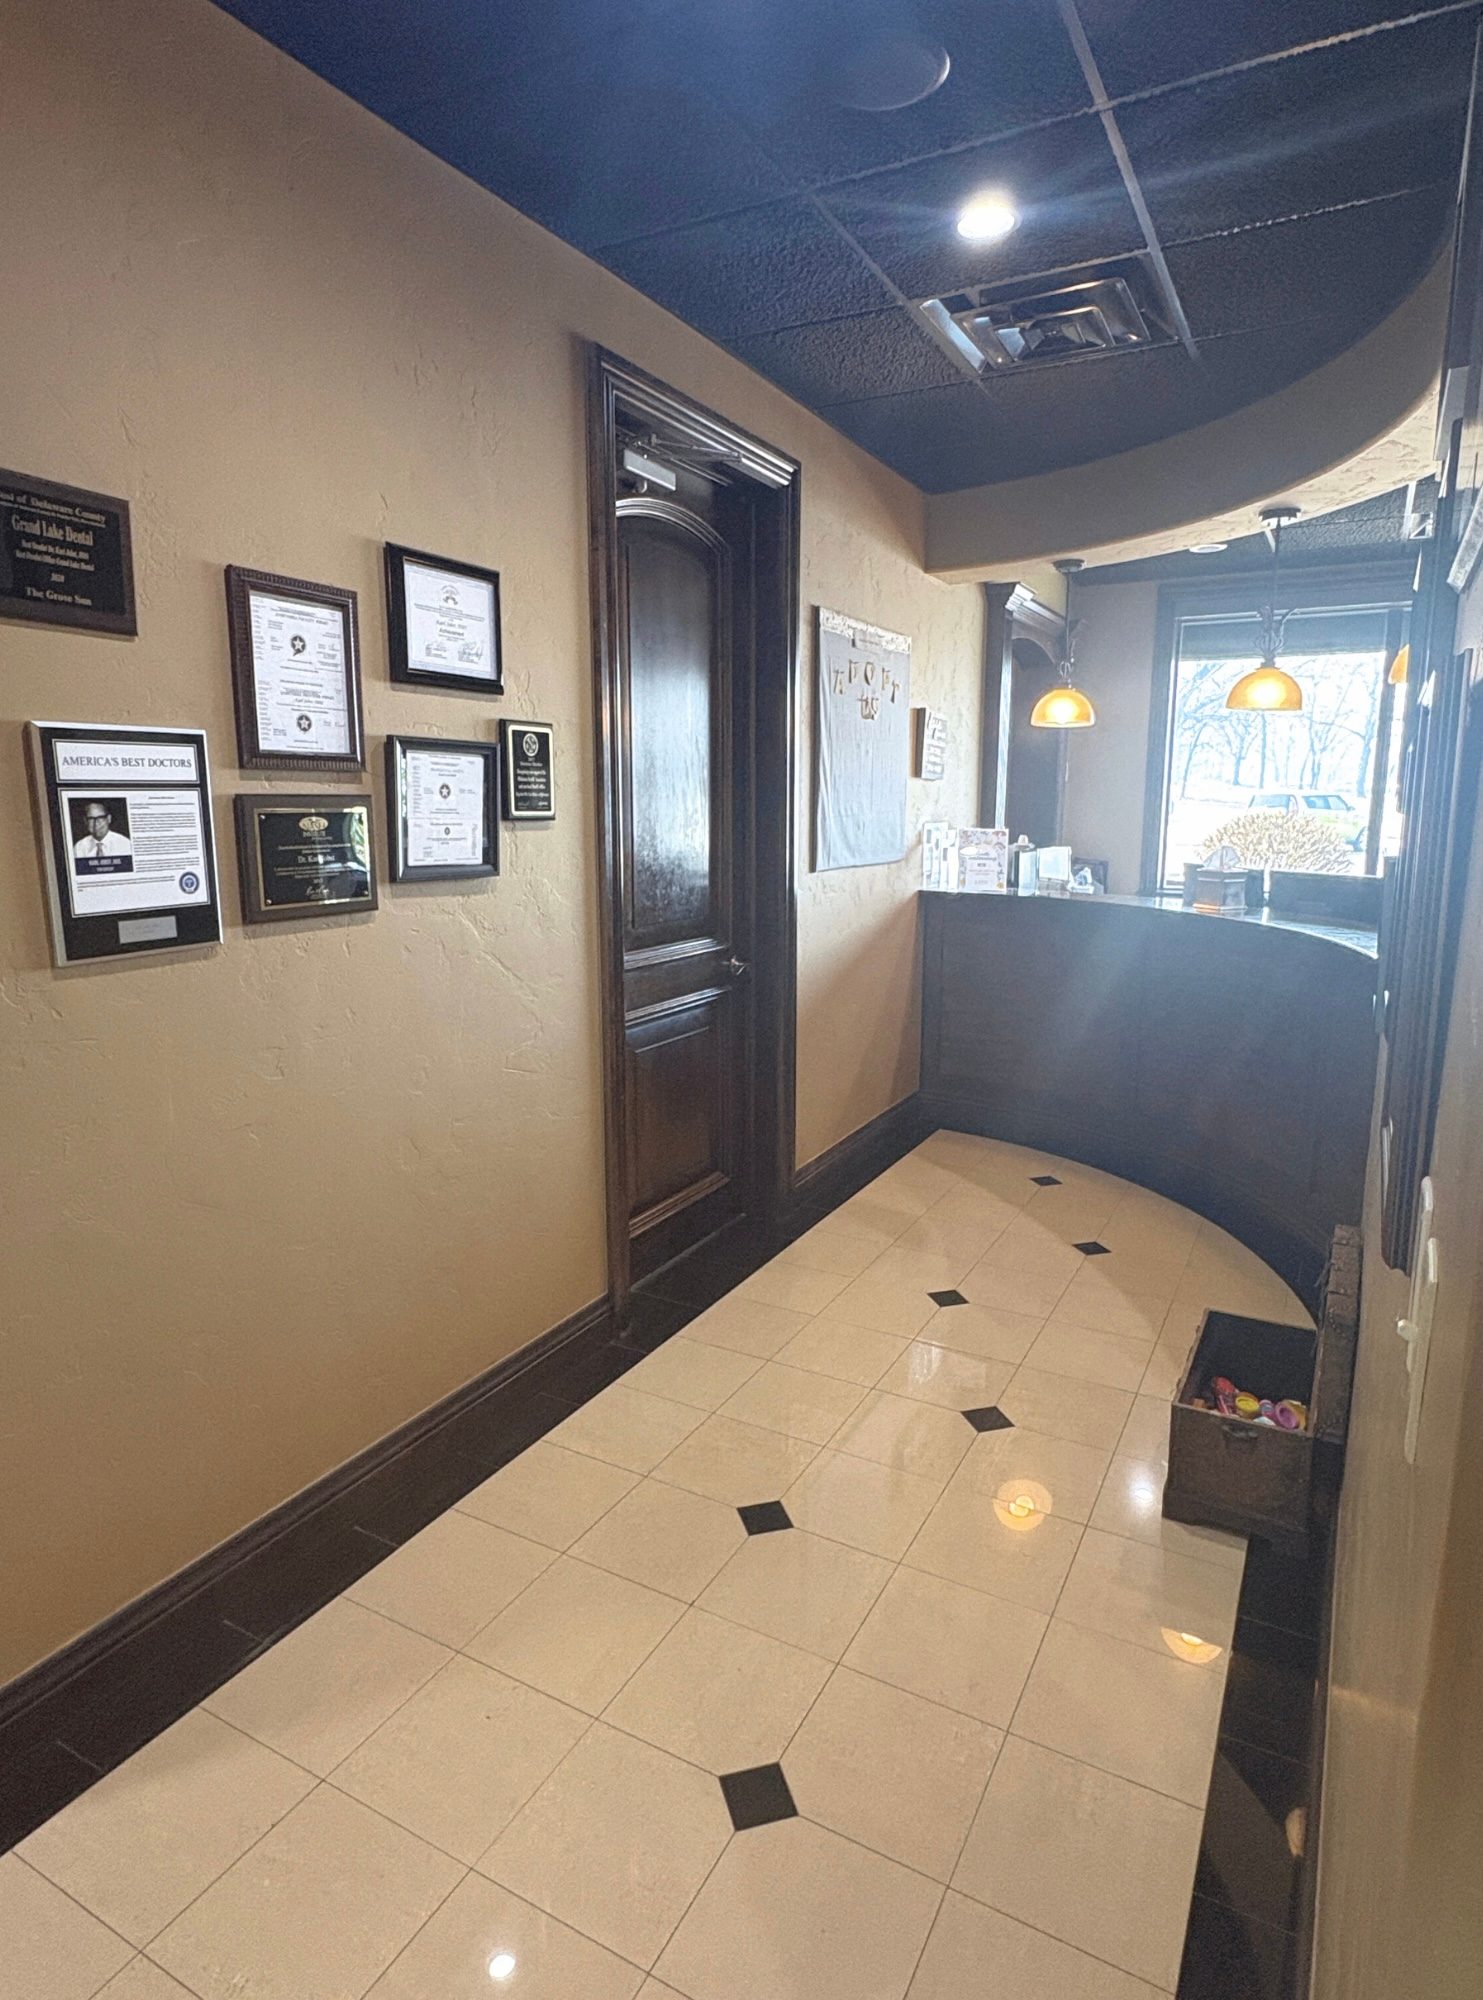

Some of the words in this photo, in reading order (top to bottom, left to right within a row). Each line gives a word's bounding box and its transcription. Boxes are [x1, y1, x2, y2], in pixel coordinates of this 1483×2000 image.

[31, 497, 74, 515] Delaware
[75, 508, 106, 524] County
[12, 514, 41, 536] Grand
[42, 520, 65, 540] Lake
[65, 526, 94, 547] Dental
[25, 587, 45, 598] The
[46, 590, 74, 603] Grove
[62, 756, 120, 768] AMERICA'S
[121, 757, 146, 768] BEST
[147, 758, 193, 768] DOCTORS
